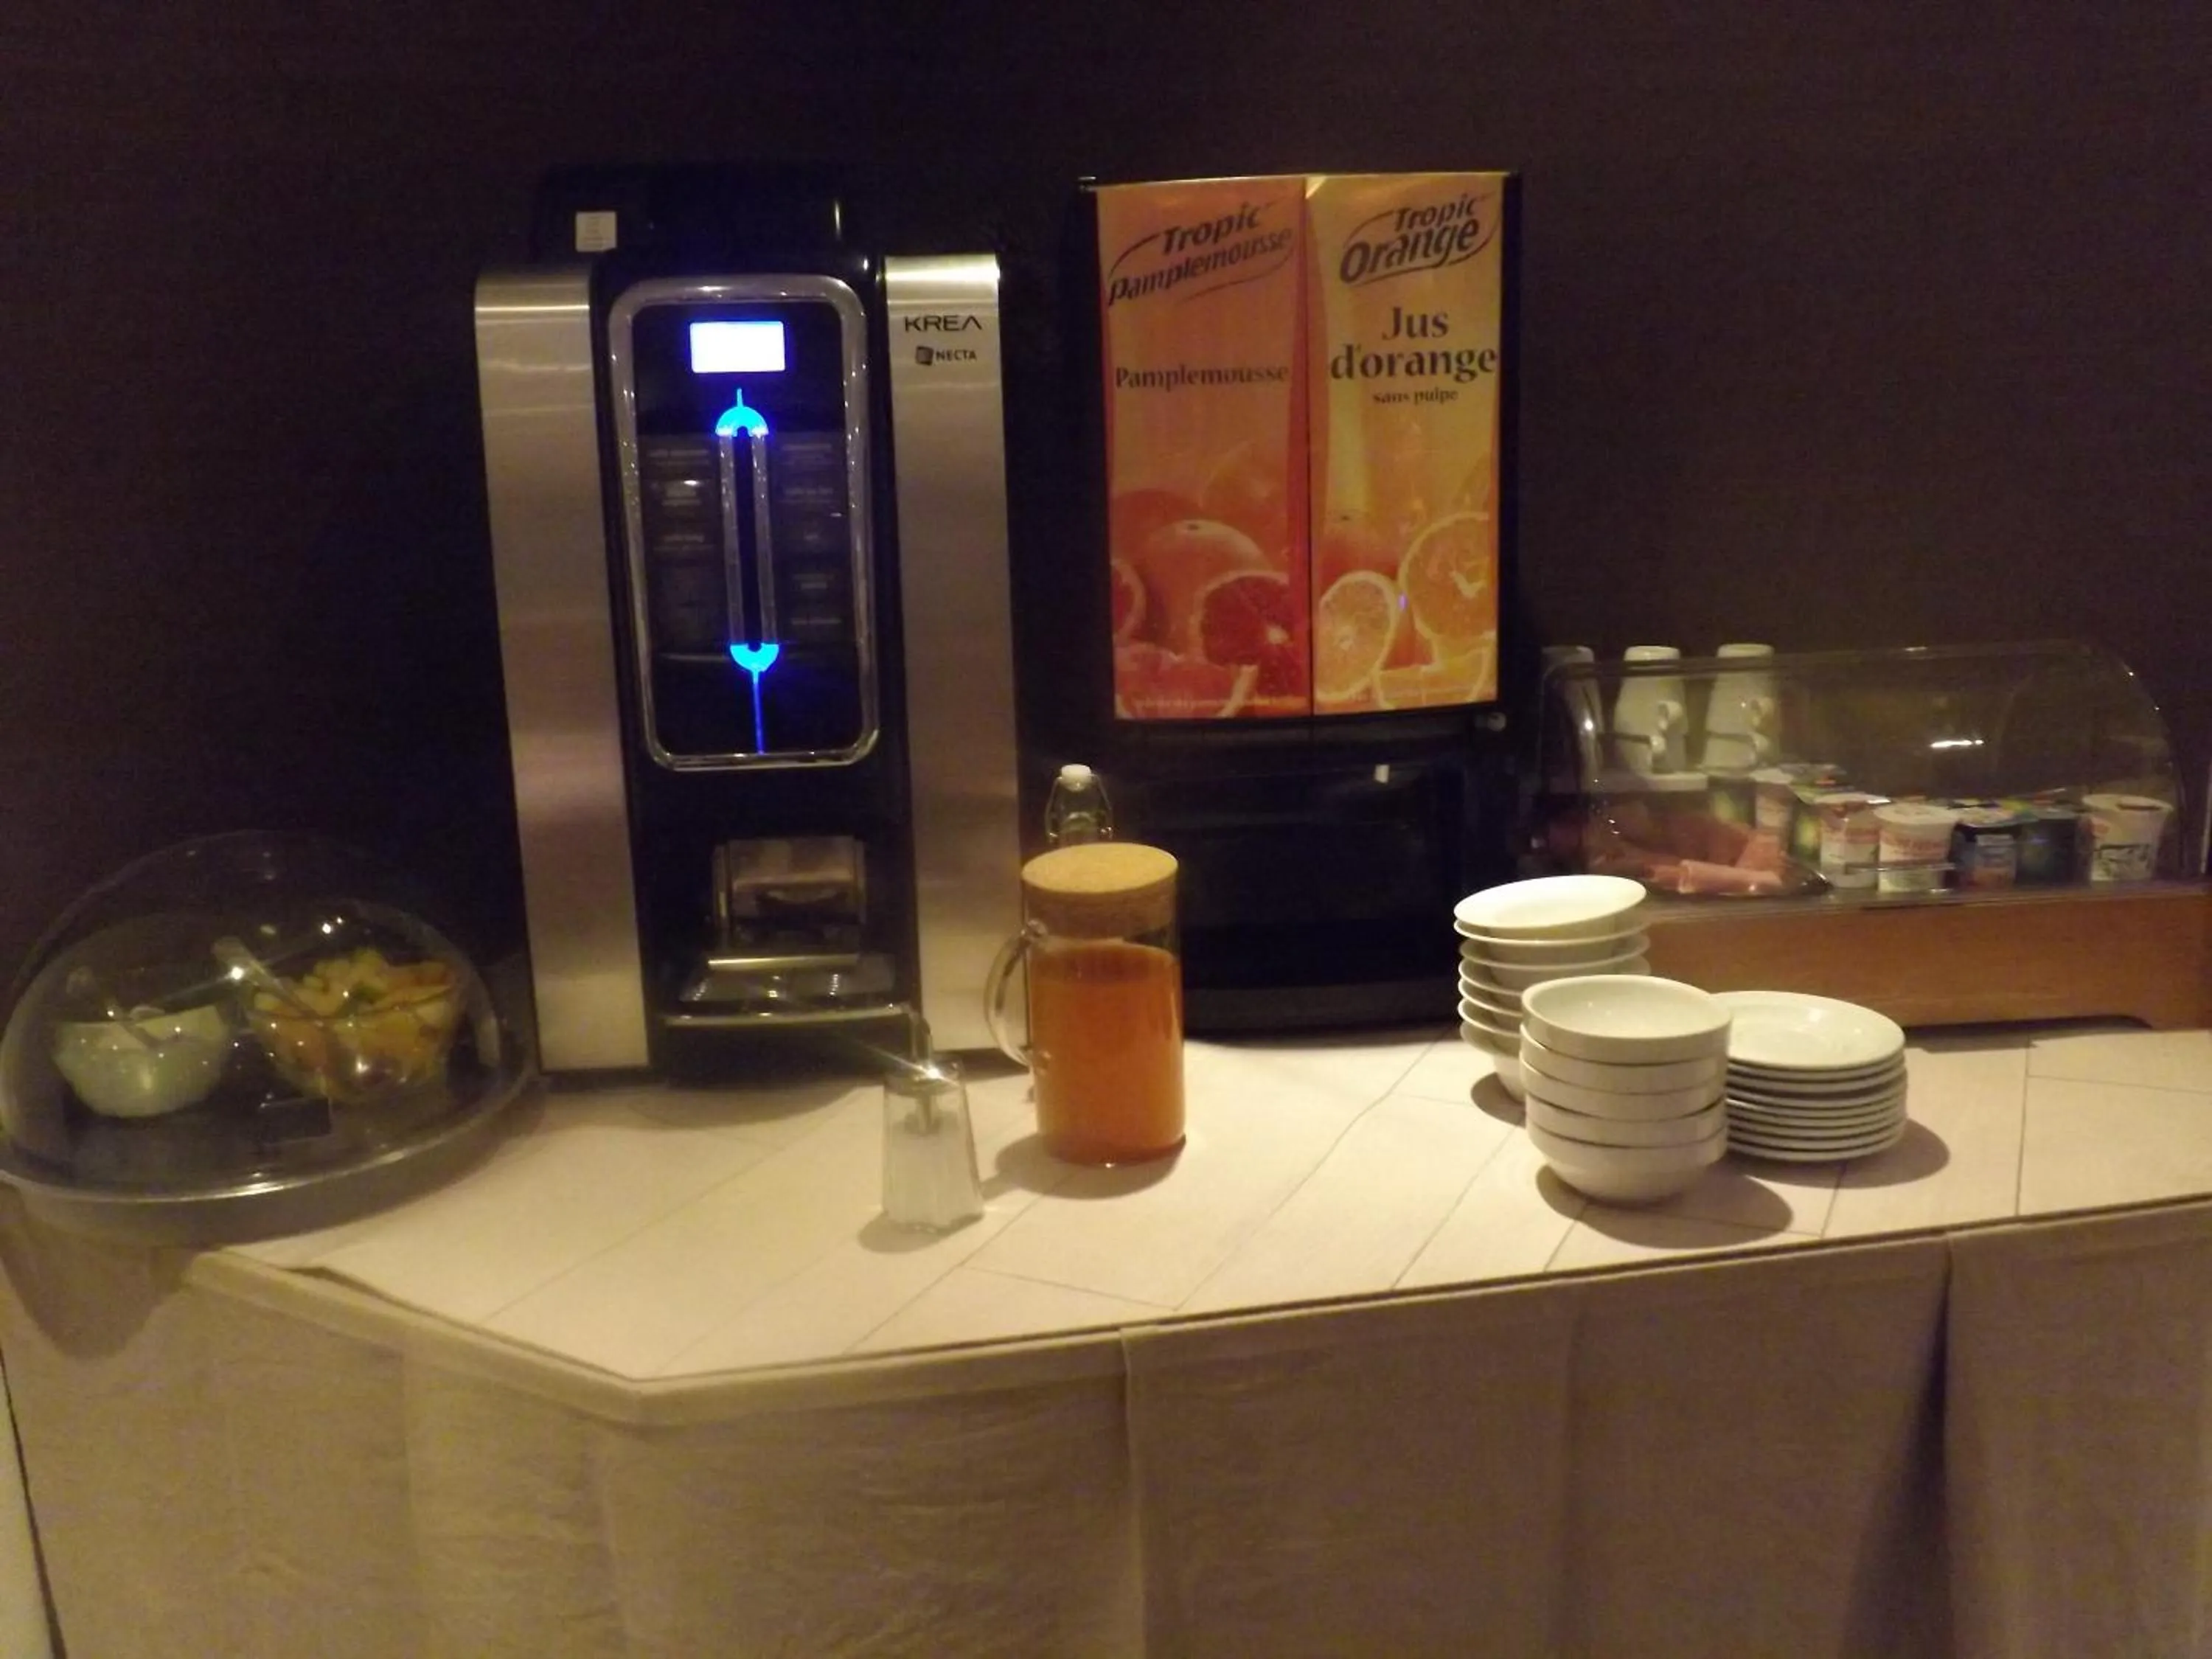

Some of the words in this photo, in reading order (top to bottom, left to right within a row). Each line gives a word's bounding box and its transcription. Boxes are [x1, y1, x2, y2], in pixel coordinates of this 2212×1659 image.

[1163, 202, 1262, 255] Tropic
[1394, 193, 1478, 232] Tropic
[1340, 218, 1481, 284] Orange
[1382, 306, 1449, 341] Jus
[936, 349, 977, 361] NECTA
[1330, 343, 1498, 383] d'orange
[1116, 365, 1289, 392] Pamplemousse
[1372, 391, 1410, 403] sans
[1413, 387, 1458, 406] pulpe
